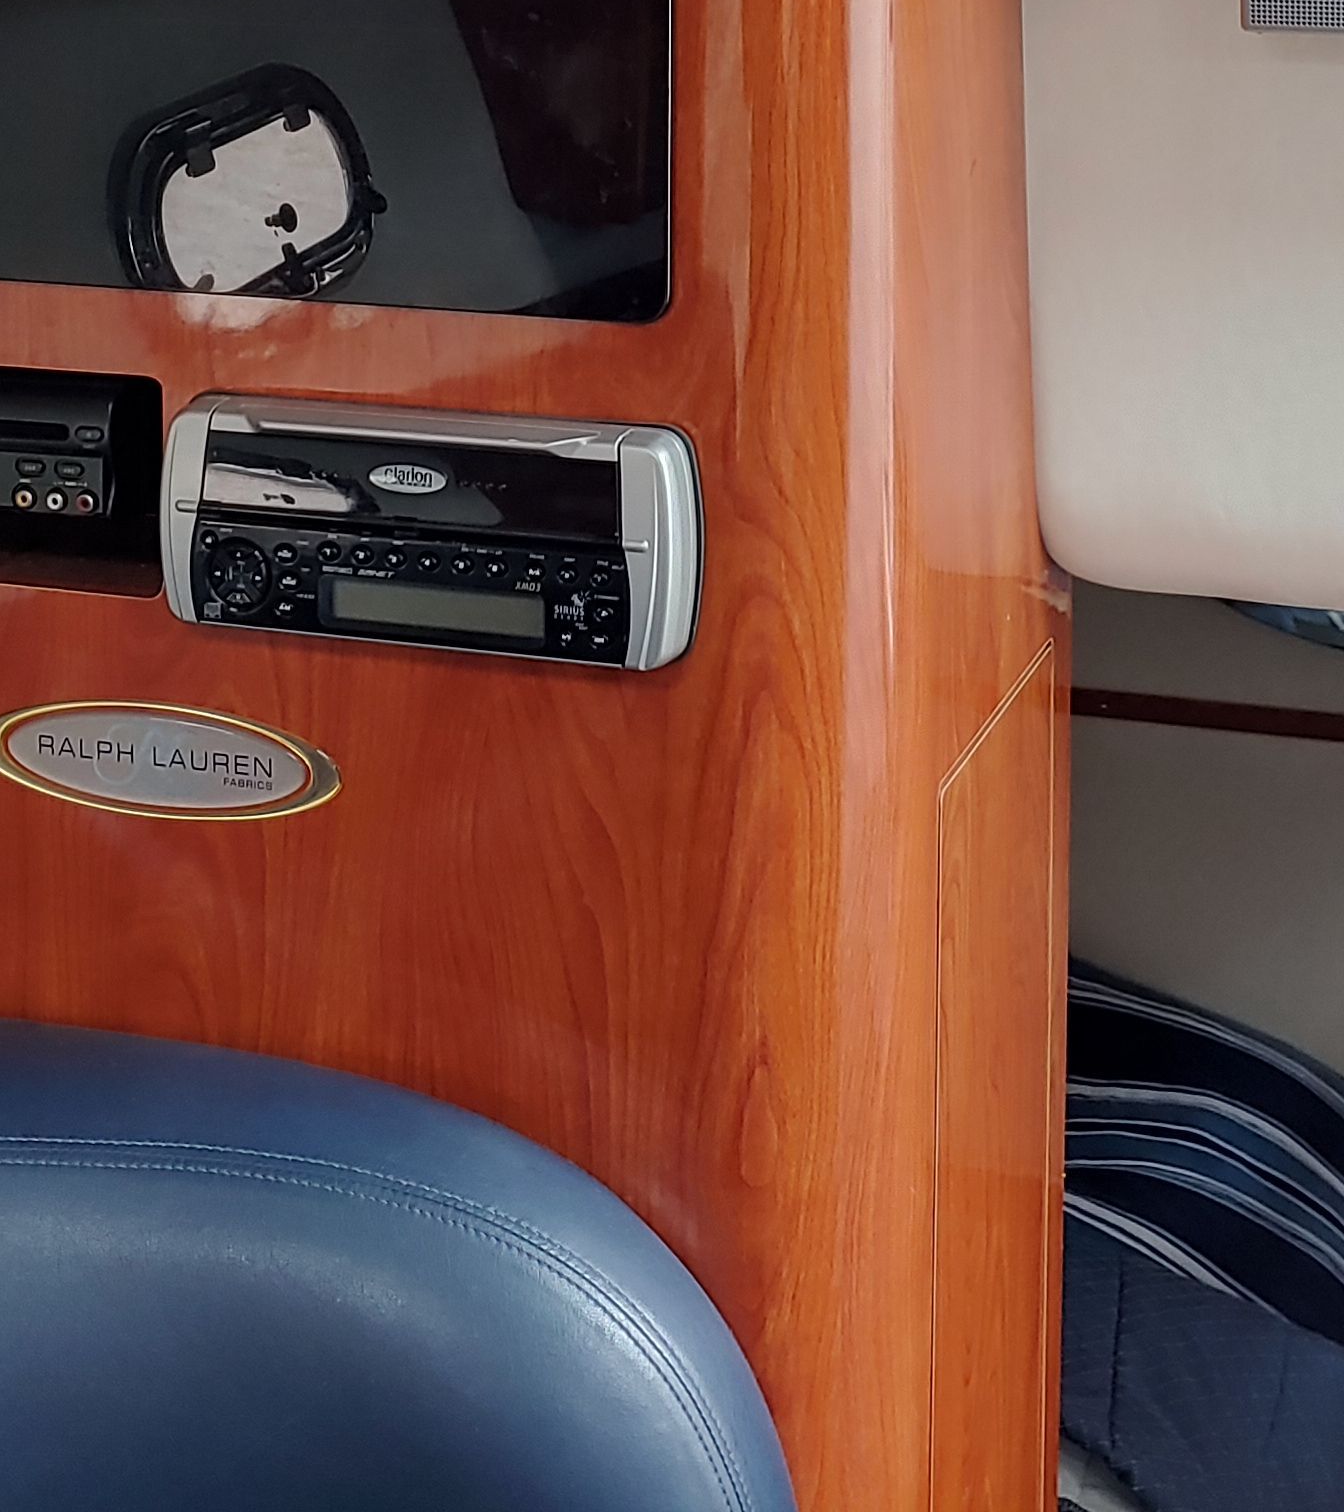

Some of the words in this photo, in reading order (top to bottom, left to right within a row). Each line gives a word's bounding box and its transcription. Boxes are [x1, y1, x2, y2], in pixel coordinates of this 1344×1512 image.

[554, 604, 585, 616] SIRIUS
[38, 733, 135, 765] RALPH
[151, 745, 274, 779] LAUREN
[222, 776, 274, 792] FABRICS
